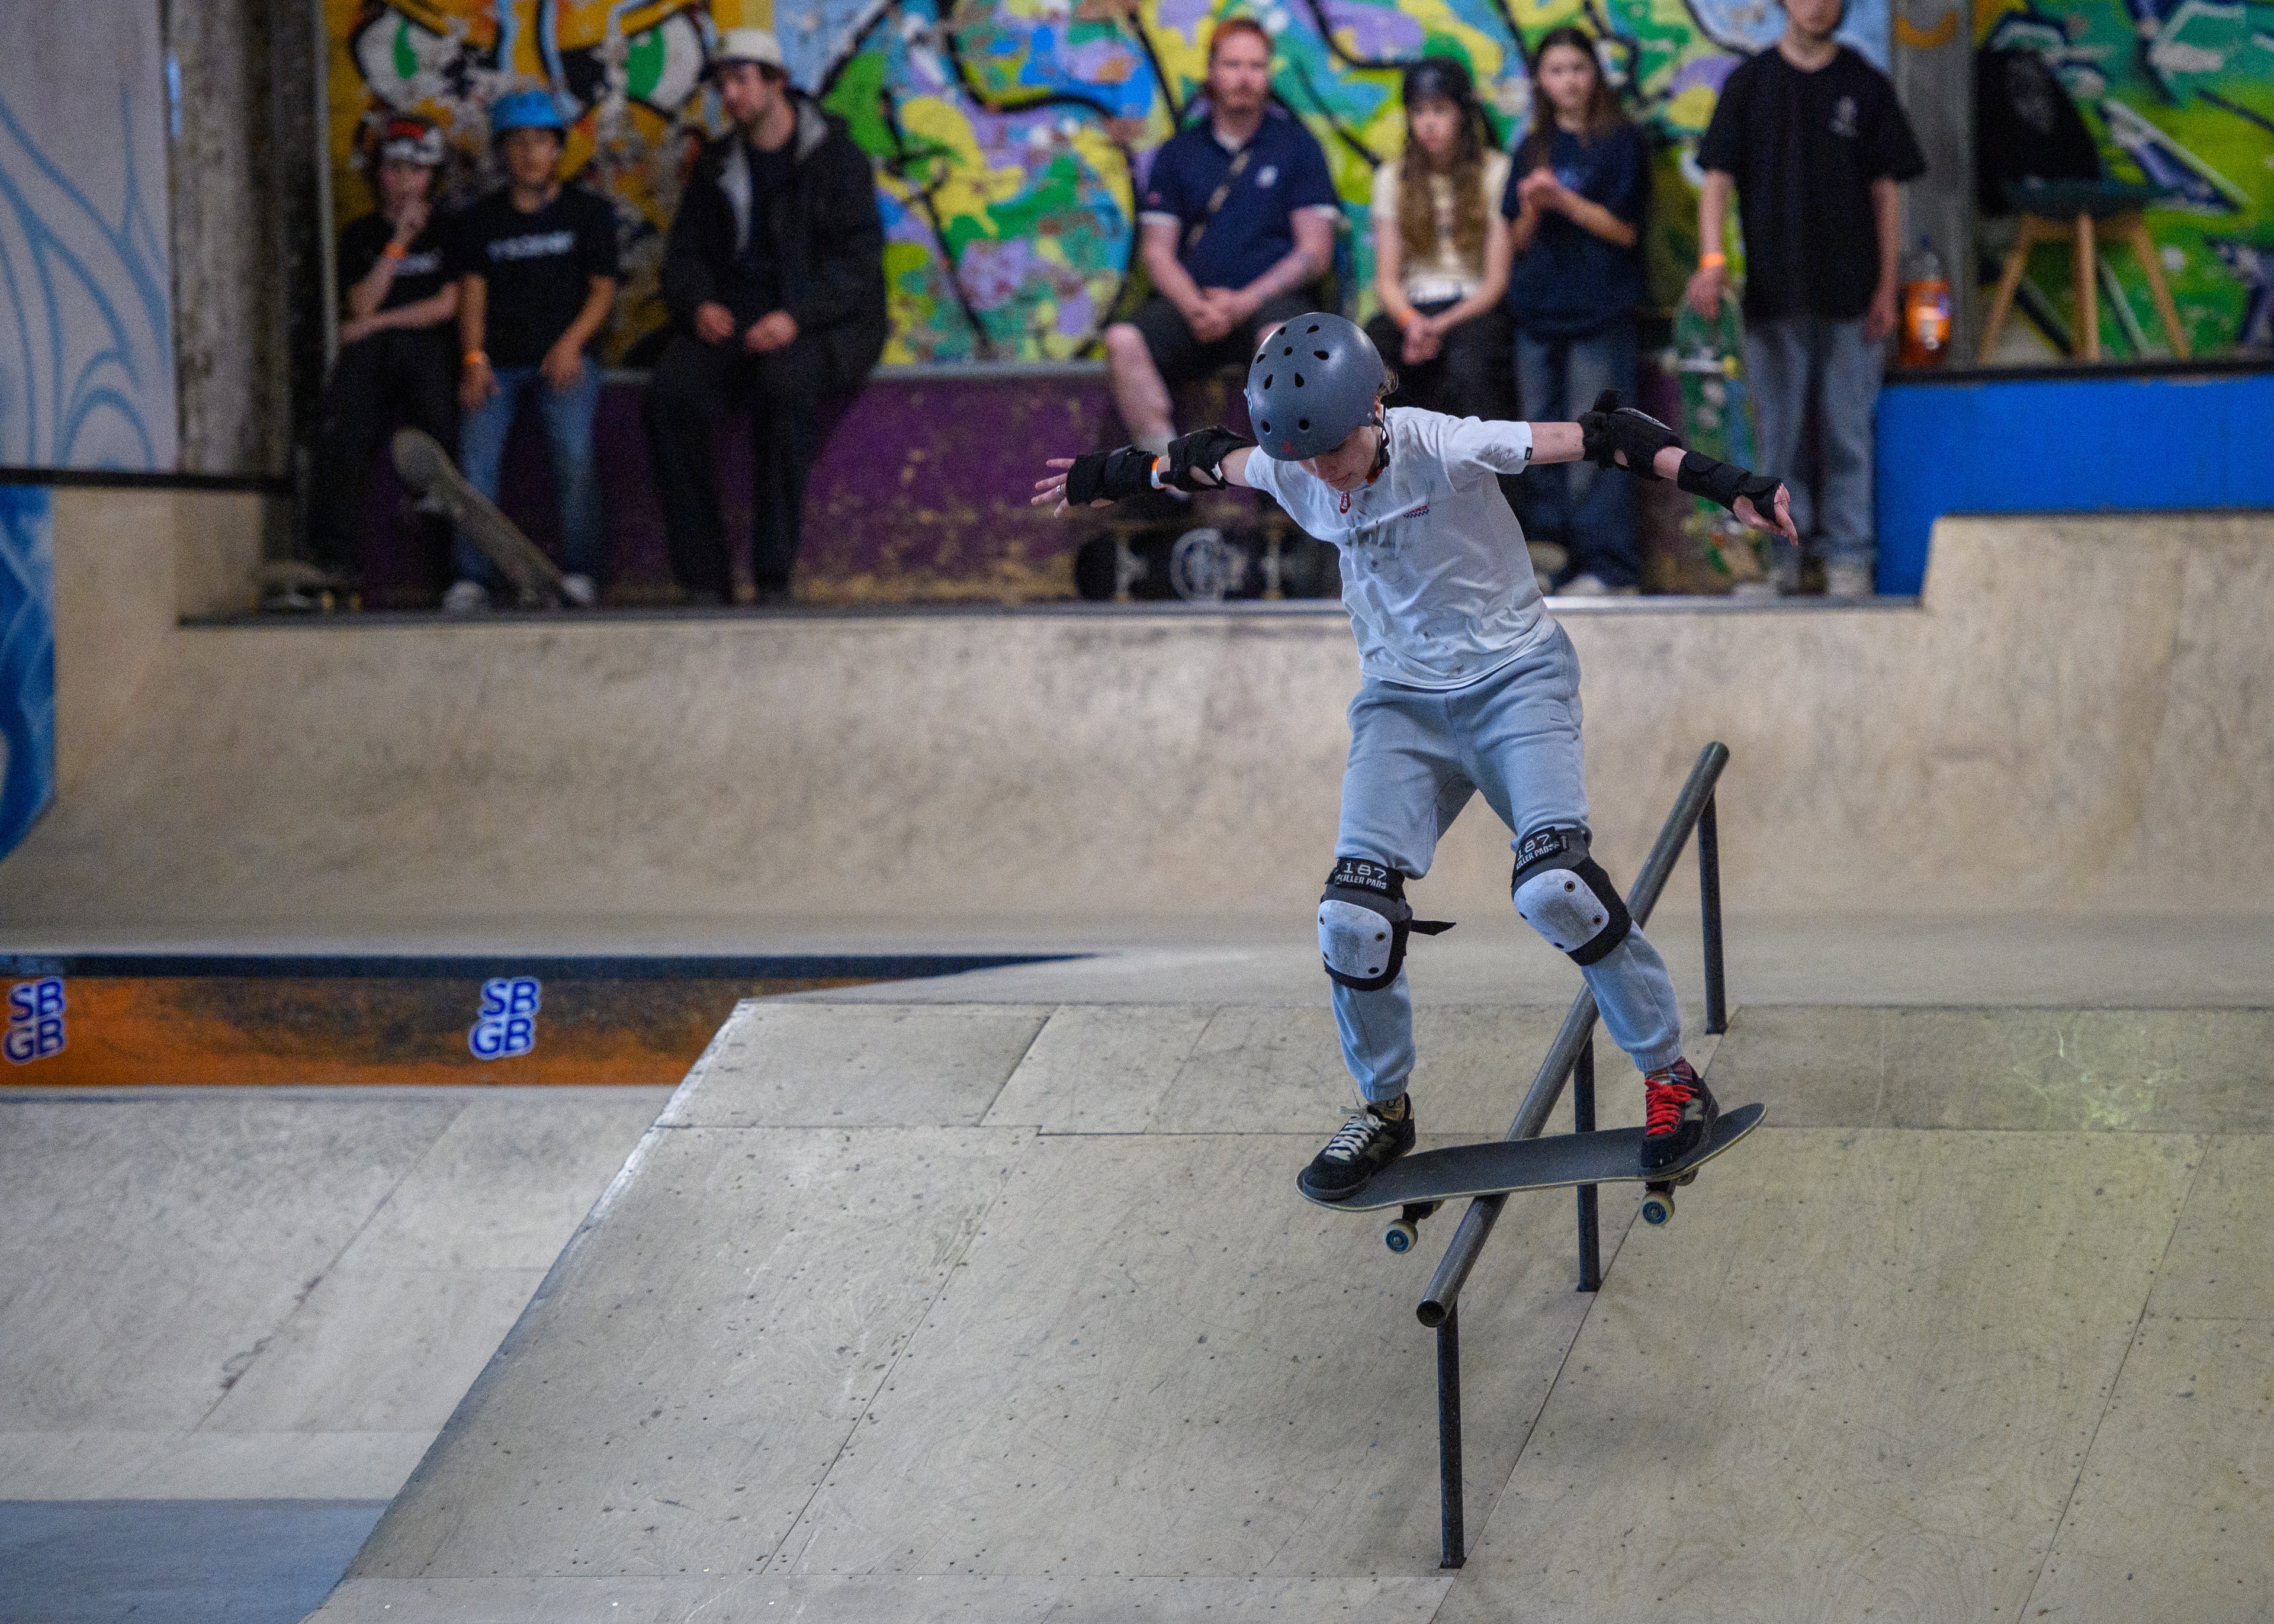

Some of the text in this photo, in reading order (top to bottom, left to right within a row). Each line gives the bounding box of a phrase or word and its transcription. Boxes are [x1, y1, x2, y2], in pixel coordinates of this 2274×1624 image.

[1515, 843, 1553, 870] KILLER PADS
[1517, 834, 1550, 860] 187
[1335, 874, 1387, 890] KILLER PADS
[1343, 863, 1387, 879] 187
[10, 980, 65, 1021] SB
[483, 981, 537, 1015] SB
[7, 1018, 66, 1060] GB
[473, 1018, 531, 1054] GB
